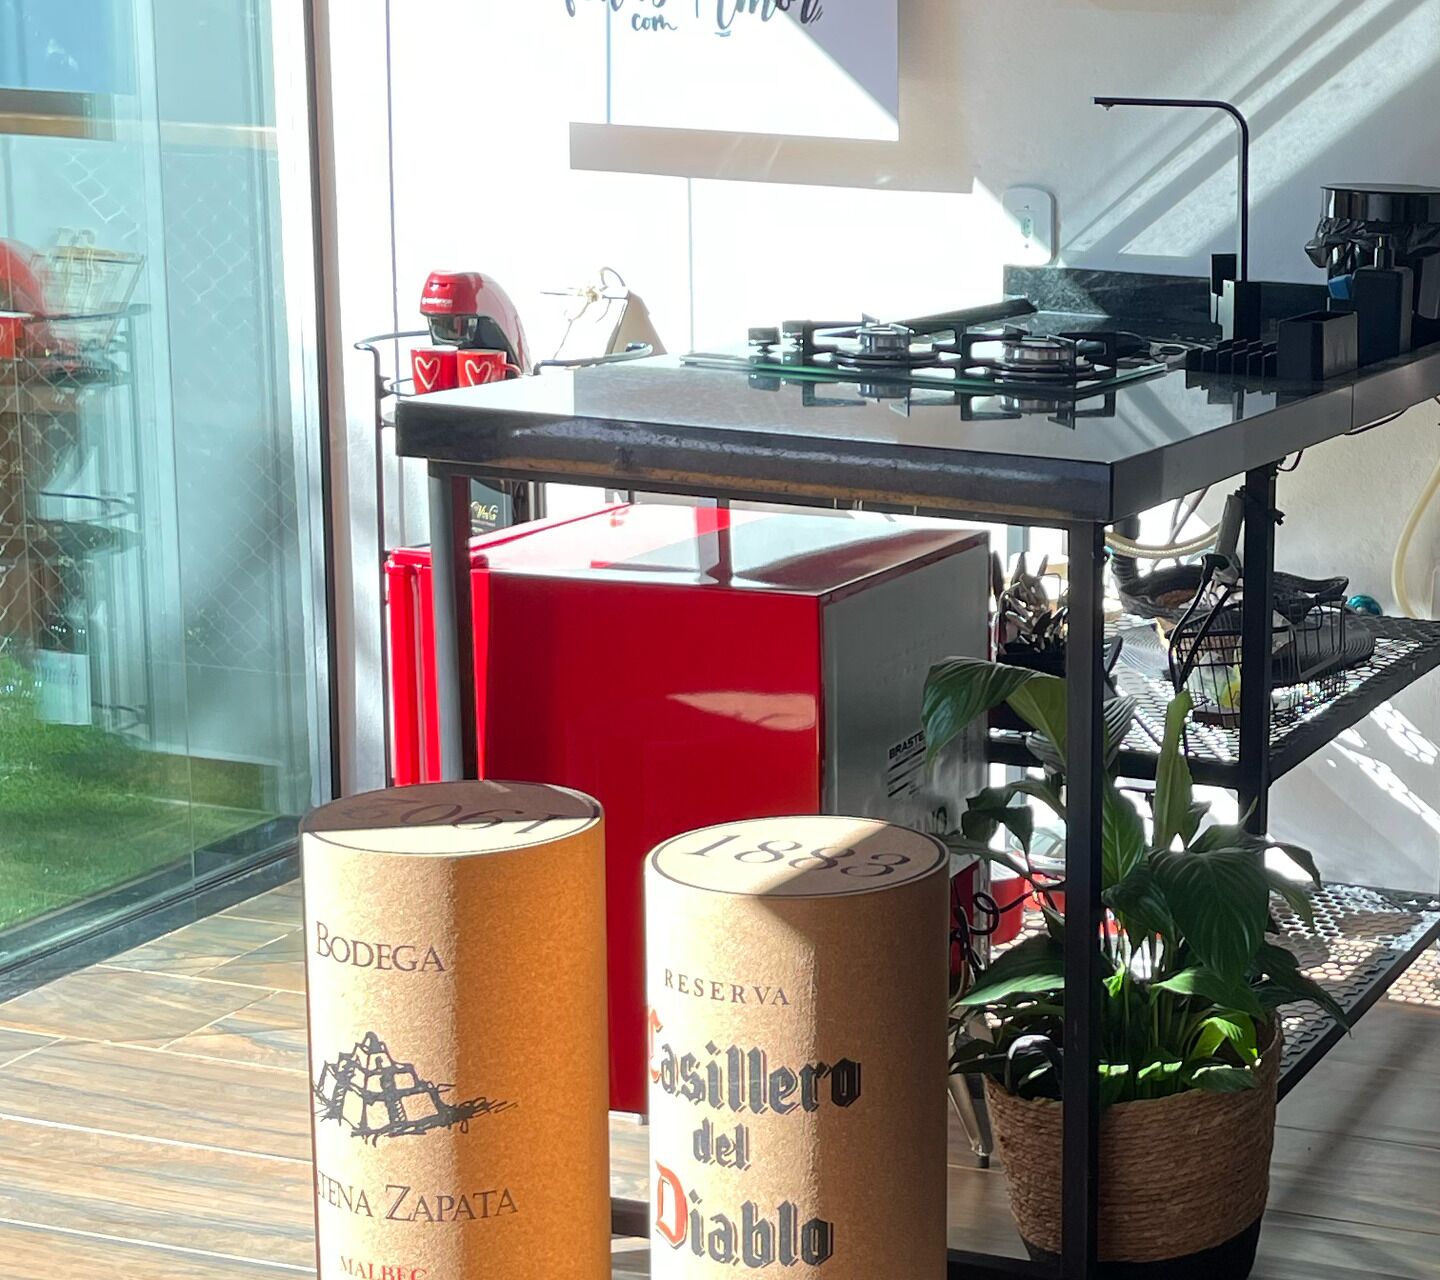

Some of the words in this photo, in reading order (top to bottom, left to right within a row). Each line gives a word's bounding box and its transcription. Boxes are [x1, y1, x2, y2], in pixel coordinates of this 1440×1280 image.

[632, 12, 678, 31] com
[888, 729, 926, 760] BRASTE
[683, 834, 911, 877] 1883
[316, 921, 447, 972] BODEGA
[664, 968, 792, 1006] RESERVA
[692, 1117, 751, 1170] del
[317, 1170, 374, 1218] TENA
[385, 1184, 518, 1222] ZAPATA
[656, 1162, 834, 1269] Diablo
